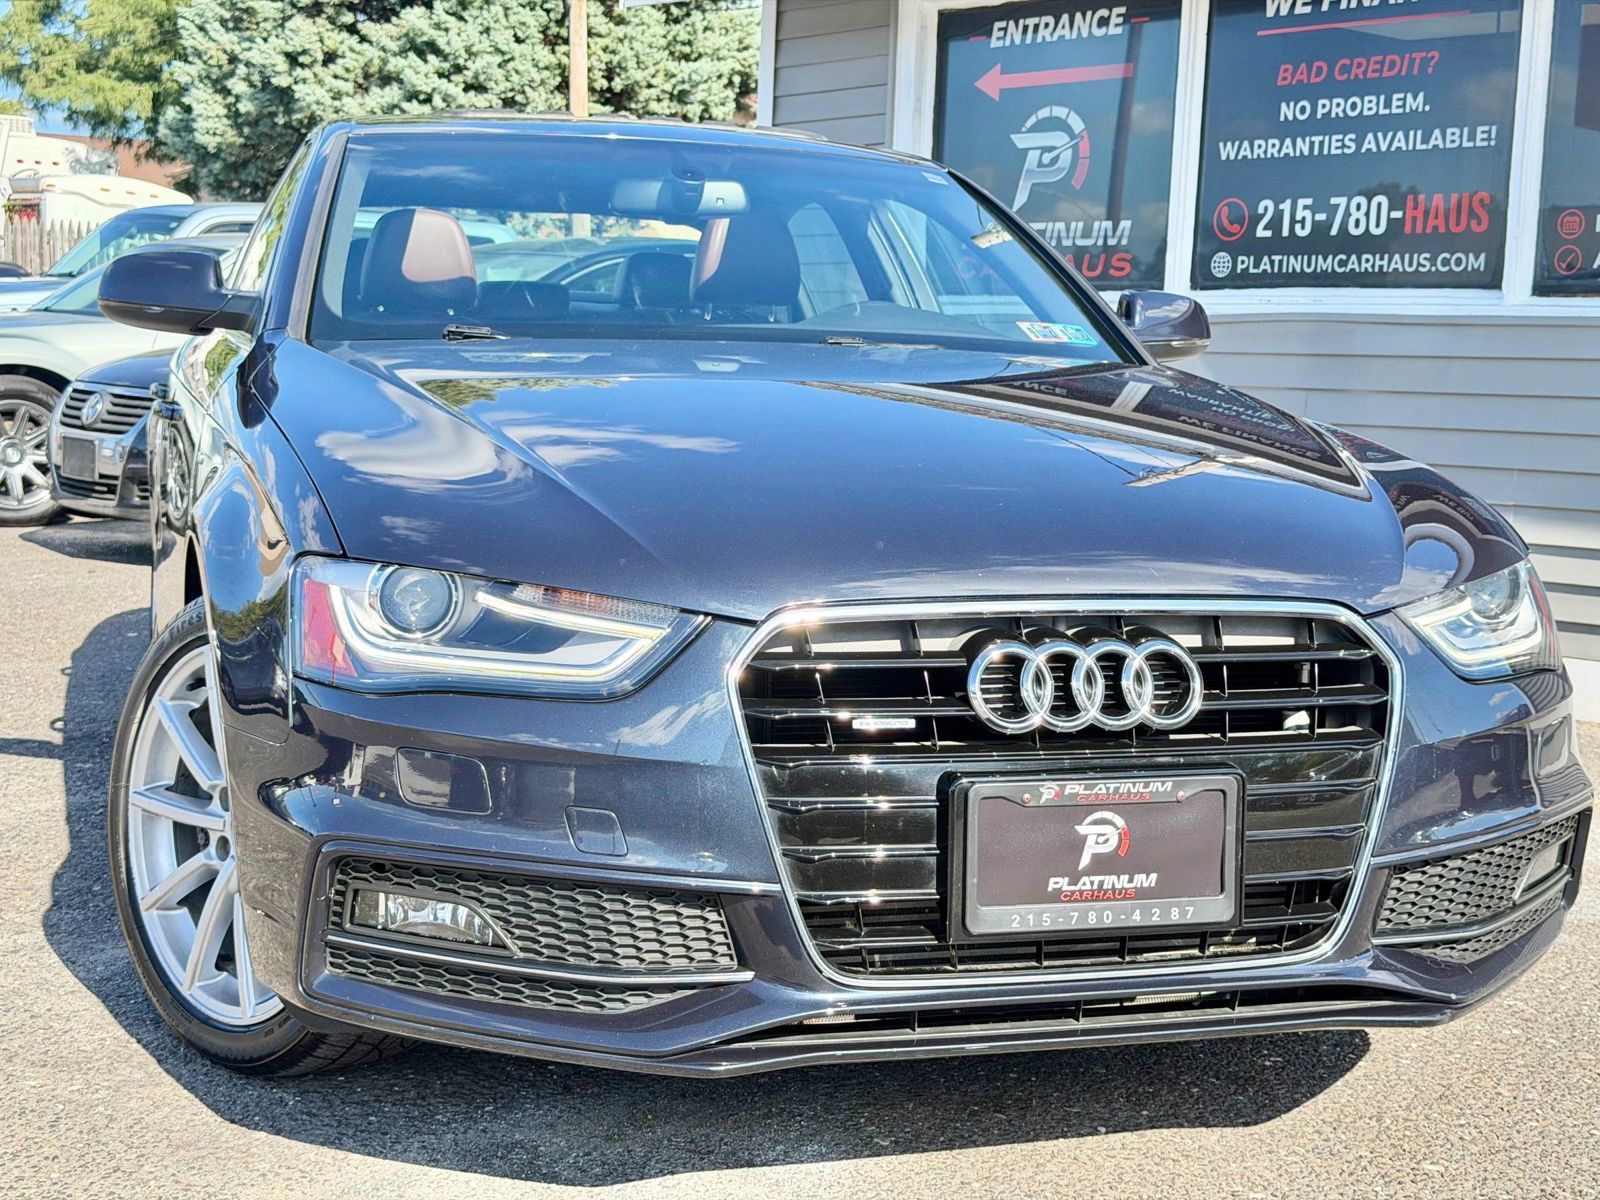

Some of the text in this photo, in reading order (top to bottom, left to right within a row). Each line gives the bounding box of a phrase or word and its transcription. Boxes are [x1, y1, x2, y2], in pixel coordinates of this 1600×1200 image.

[989, 6, 1127, 48] ENTRANCE
[1277, 50, 1440, 86] BAD CREDIT?
[1279, 91, 1431, 122] NO PROBLEM.
[1218, 125, 1497, 161] WARRANTIES AVAILABLE!
[1255, 191, 1491, 238] 215-780-HAUS
[1028, 219, 1132, 247] TINUM
[1236, 252, 1486, 274] PLATINUMCARHAUS.COM
[169, 611, 203, 640] Fires
[1063, 781, 1173, 795] PLATINUM
[1076, 793, 1152, 803] CARHAUS
[1047, 872, 1158, 892] PLATINUM
[1060, 888, 1136, 901] CARHAUS
